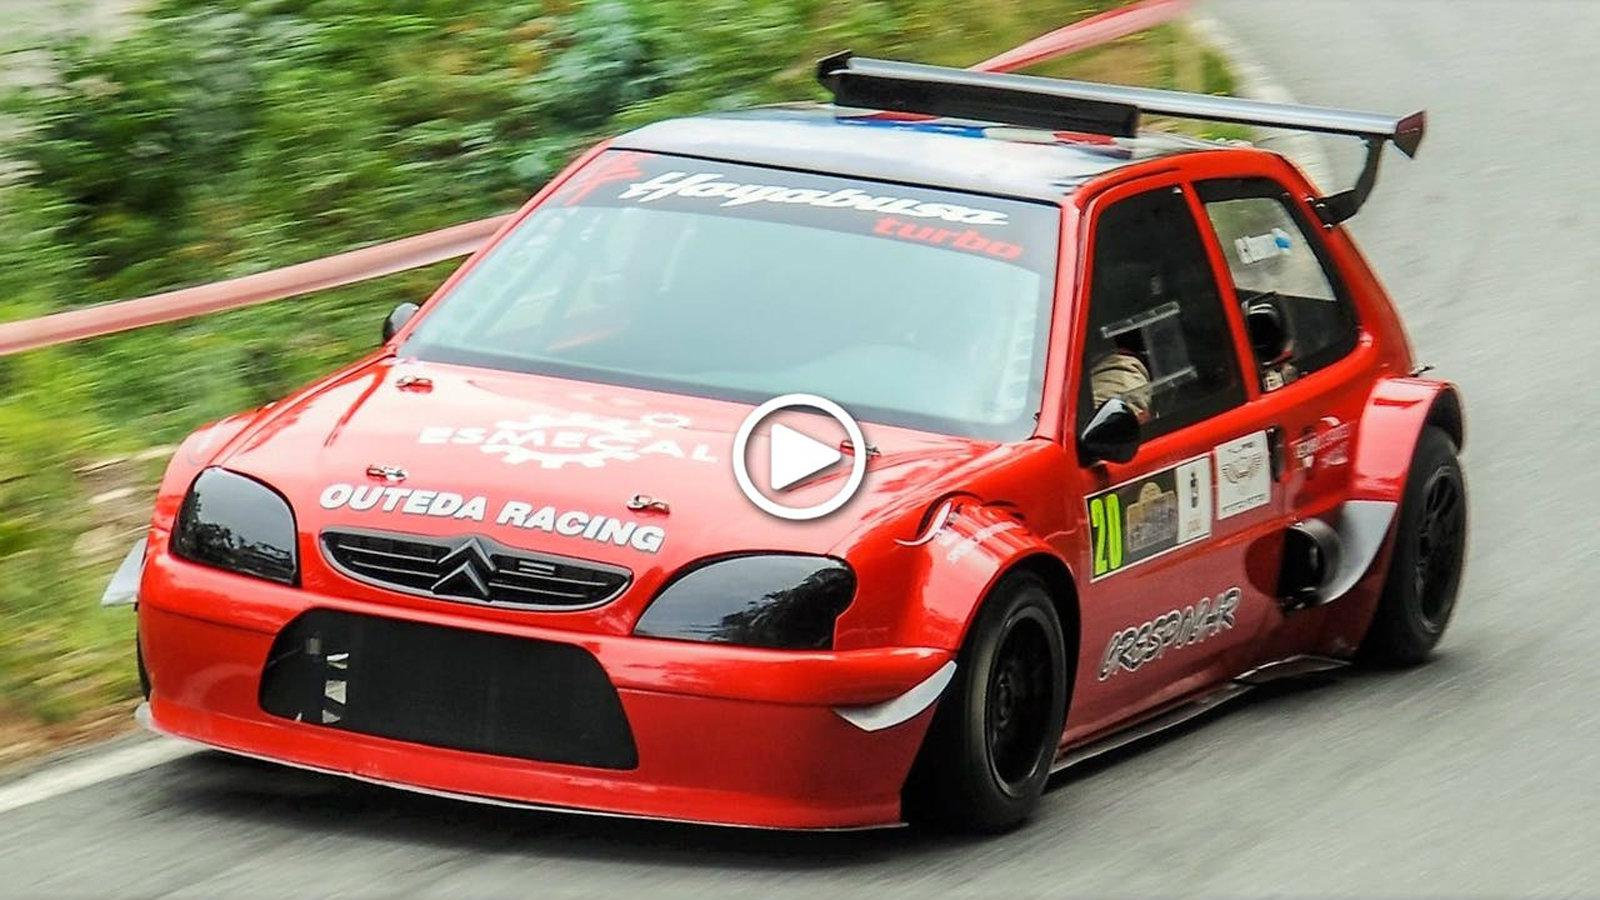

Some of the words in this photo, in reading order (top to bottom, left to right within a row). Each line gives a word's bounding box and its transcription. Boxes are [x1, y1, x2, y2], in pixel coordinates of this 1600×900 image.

[619, 172, 1009, 225] Hayabusa
[873, 217, 1022, 260] turbo
[418, 426, 719, 463] ESMECAL
[319, 484, 490, 522] OUTEDA
[496, 502, 666, 554] RACING
[1090, 493, 1122, 575] 20
